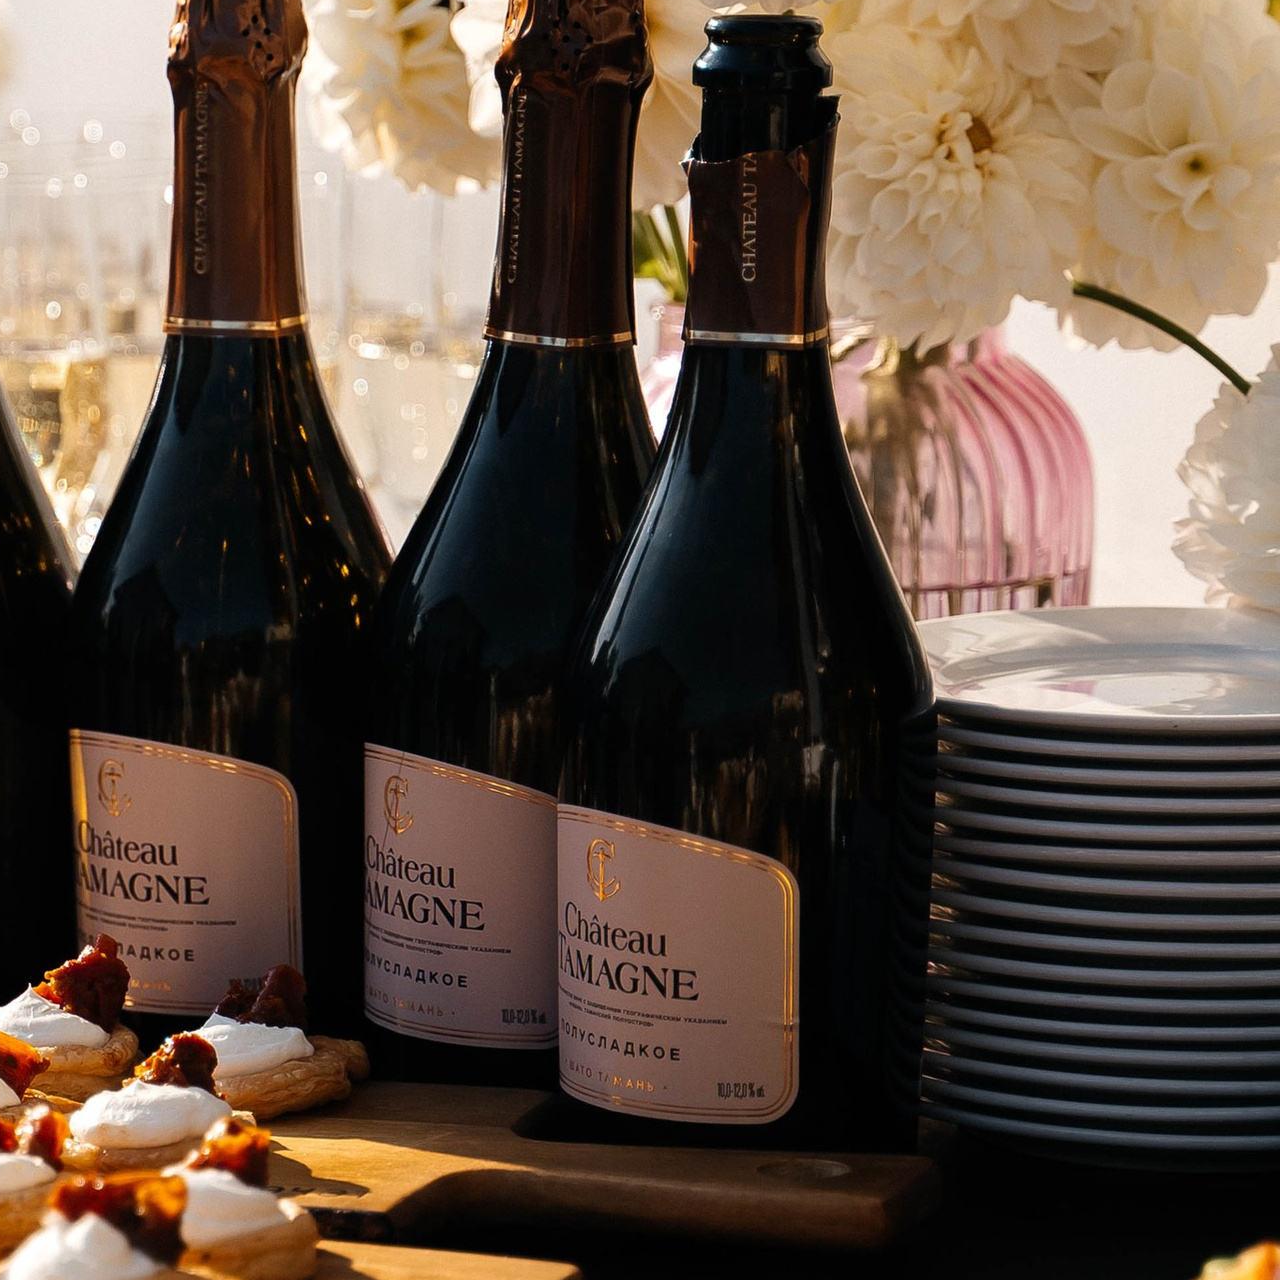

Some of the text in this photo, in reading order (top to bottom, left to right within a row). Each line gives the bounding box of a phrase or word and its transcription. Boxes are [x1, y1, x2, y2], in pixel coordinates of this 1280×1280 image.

[194, 182, 208, 275] CHATEAU
[507, 189, 521, 284] CHATEAU
[741, 182, 758, 283] CHATEAU
[78, 821, 178, 866] Château
[366, 835, 456, 889] Château
[79, 862, 209, 905] AMAGNE
[365, 878, 485, 930] AMAGNE
[565, 901, 667, 957] Château
[559, 931, 699, 1001] TAMAGNE
[561, 1017, 682, 1062] ПОЛУСЛАДКОЕ
